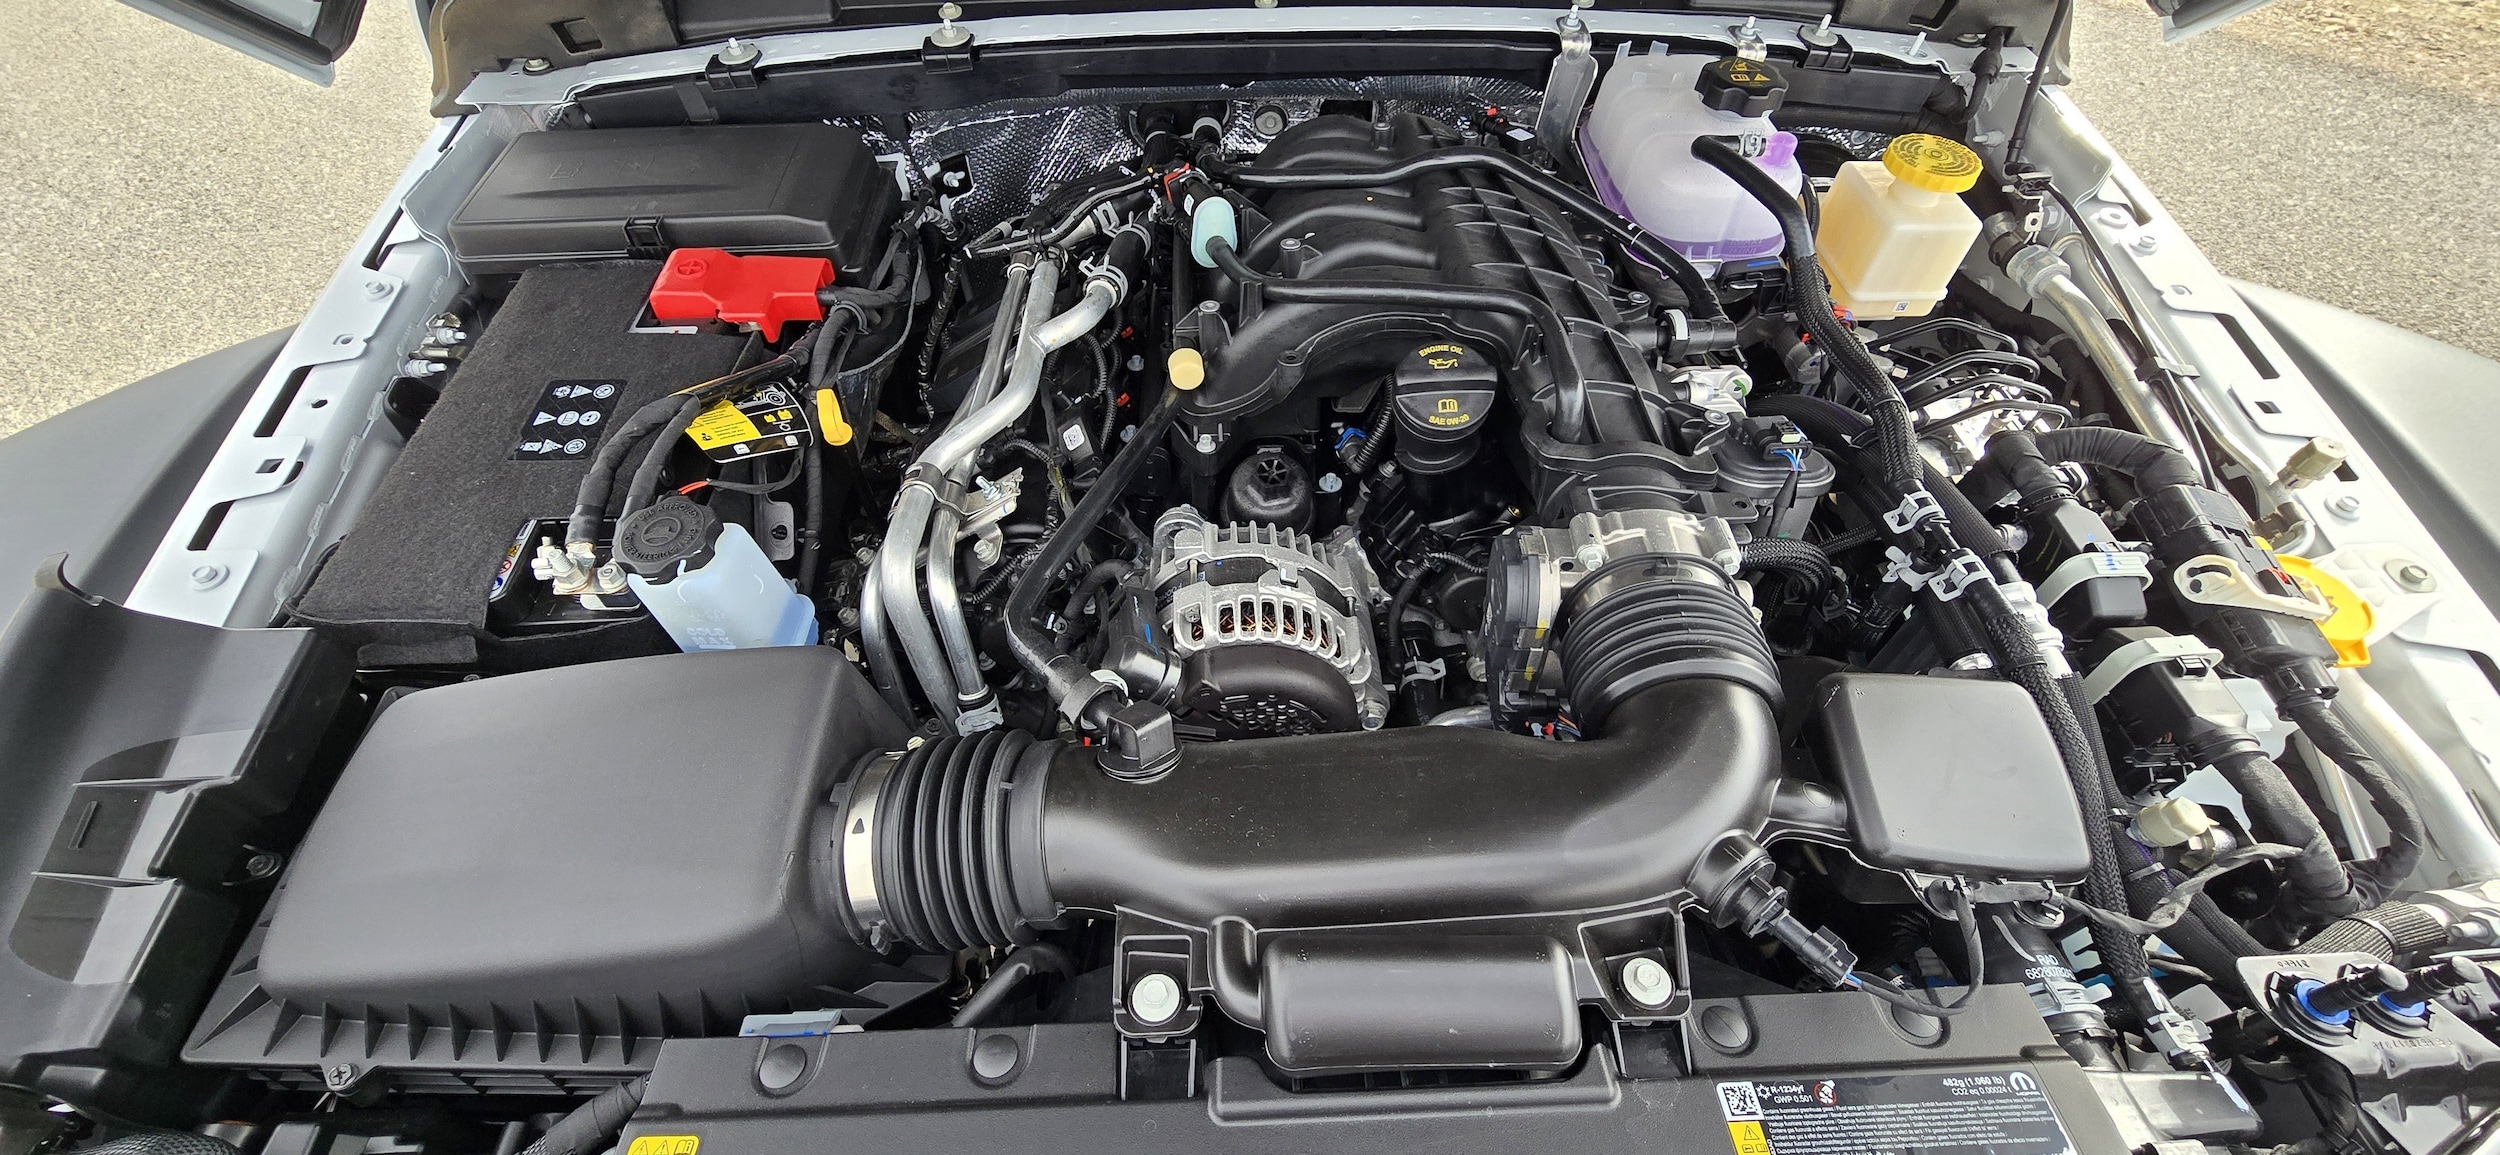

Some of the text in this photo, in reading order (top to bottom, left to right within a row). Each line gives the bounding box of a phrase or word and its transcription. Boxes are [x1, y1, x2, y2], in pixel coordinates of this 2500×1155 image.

[1418, 344, 1463, 357] ENGINE OIL
[1428, 413, 1470, 426] SAE 0W-20
[657, 502, 698, 518] APPROVED
[2036, 954, 2059, 966] RAD
[1770, 1084, 1805, 1094] R-1234yf
[1951, 1087, 1969, 1096] CO2
[1773, 1094, 1814, 1104] GWP 0.501
